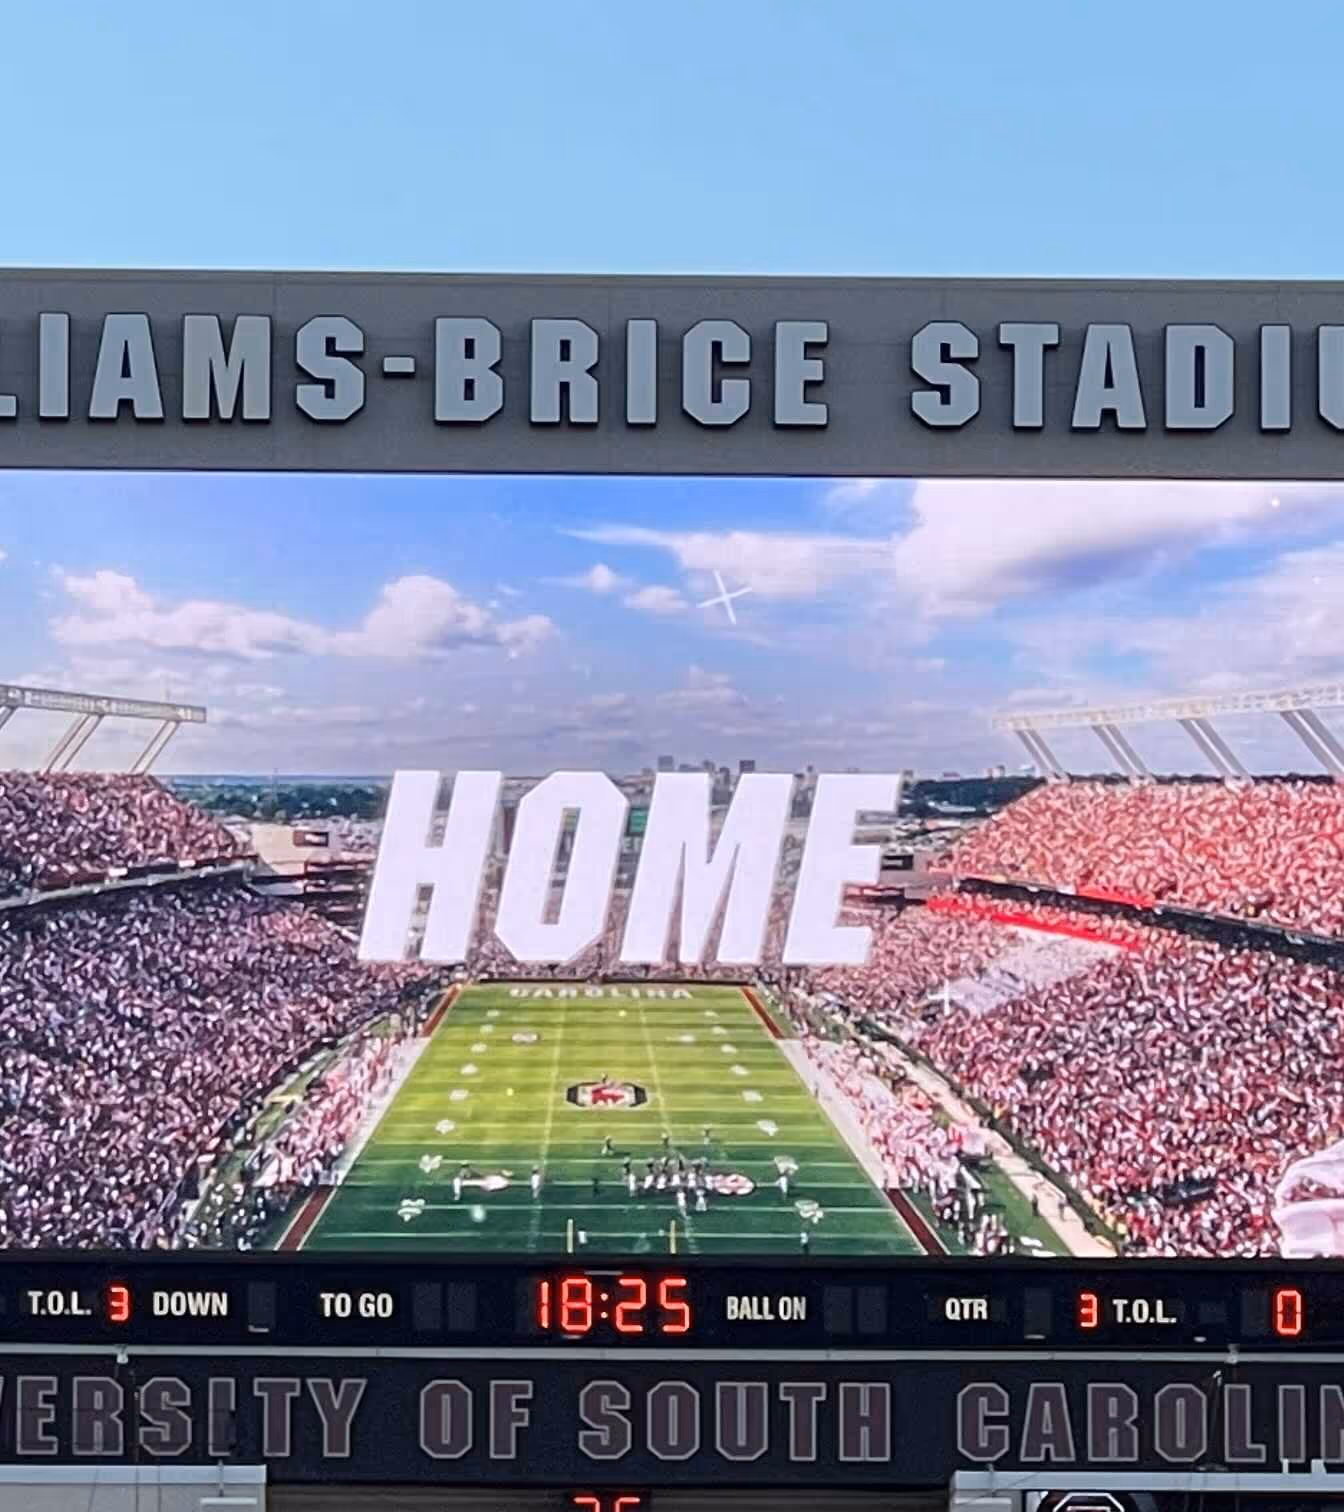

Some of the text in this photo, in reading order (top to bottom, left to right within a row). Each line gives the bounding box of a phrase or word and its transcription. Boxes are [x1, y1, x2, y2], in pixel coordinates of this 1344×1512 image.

[357, 769, 903, 967] HOME
[27, 1290, 92, 1316] T.O.L.
[110, 1287, 129, 1322] 3
[152, 1290, 228, 1317] DOWN
[320, 1293, 394, 1319] TO GO
[536, 1278, 691, 1333] 18:25
[726, 1295, 807, 1322] BALL ON
[944, 1298, 988, 1321] QTR
[1080, 1292, 1098, 1328] 3
[1112, 1298, 1178, 1325] T.O.L.
[1276, 1289, 1302, 1335] 0
[419, 1379, 534, 1460] OF
[578, 1380, 892, 1463] SOUTH
